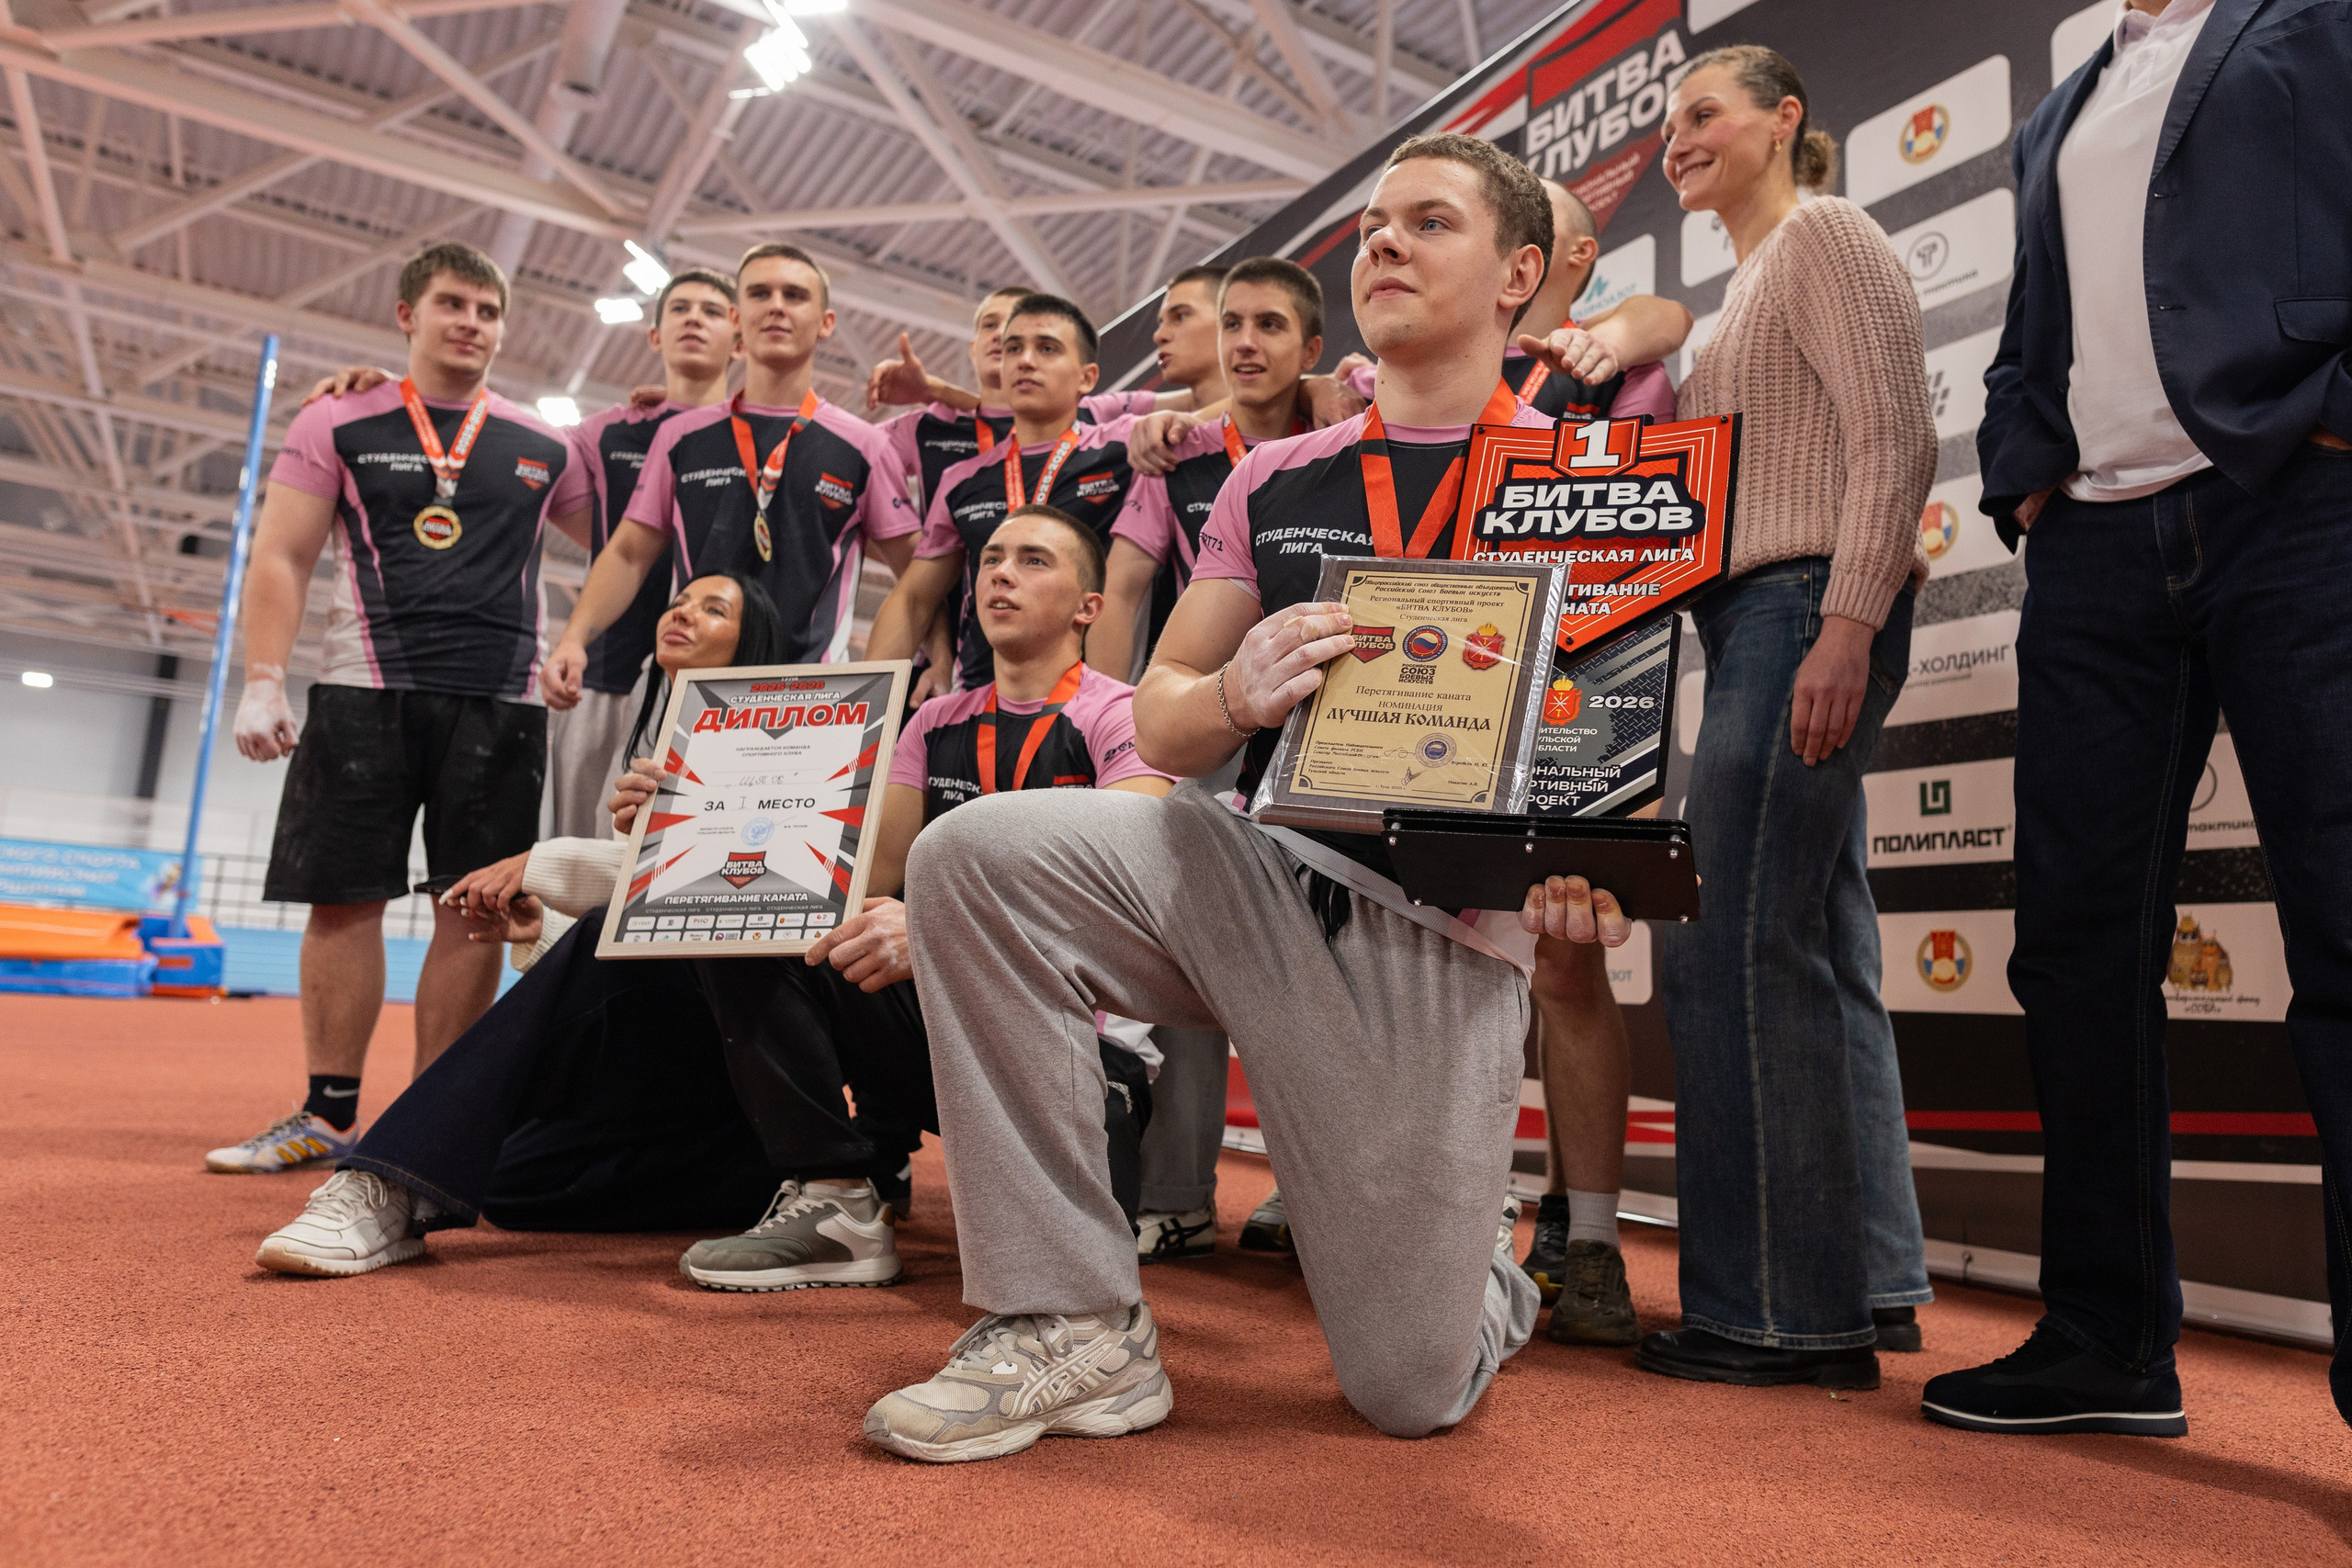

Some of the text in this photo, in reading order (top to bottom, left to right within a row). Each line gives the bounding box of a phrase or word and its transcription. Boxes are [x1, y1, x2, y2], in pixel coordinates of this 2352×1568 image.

[1525, 28, 1687, 156] БИТВА
[1527, 61, 1687, 178] ЛУБО
[1569, 420, 1620, 469] 1
[356, 453, 430, 465] СТУДЕНЧЕС
[1501, 479, 1680, 511] БИТВА
[1482, 505, 1694, 536] КЛУБОВ
[1255, 527, 1374, 547] СТУДЕНЧЕСКАЯ
[1280, 542, 1323, 555] ЛИГА
[1472, 547, 1696, 564] СТУДЕНЧЕСКАЯ ЛИГА
[1374, 585, 1416, 593] Российский
[1567, 582, 1661, 596] ГИВАНИЕ
[1370, 594, 1425, 604] Региональный
[1427, 598, 1475, 606] спортивный
[1396, 604, 1474, 614] «БИТВА КЛУБОВ»
[1564, 602, 1611, 615] НАТА
[1399, 613, 1468, 624] Студенческая лига
[1352, 634, 1391, 643] БИТВА
[1354, 641, 1394, 649] ЛУБОВ
[1909, 643, 2011, 677] -ХОЛДИНГ
[1400, 667, 1436, 676] СОЮЗ
[750, 681, 826, 693] 2025-2026
[1355, 685, 1472, 701] Перетягивание каната
[729, 692, 841, 705] СТУДЕНЧЕСКАЯ ЛИГА
[1588, 694, 1655, 710] 2026
[1377, 700, 1443, 712] НОМИНАЦИЯ
[693, 702, 869, 734] ДИПЛОМ
[1326, 707, 1491, 731] ЛУЧШАЯ КОМАНДА
[1540, 728, 1598, 736] ИТЕЛЬСТВО
[1530, 780, 1609, 793] РТИВНЫЙ
[704, 801, 725, 811] ЗА
[758, 797, 816, 810] МЕСТО
[1527, 795, 1580, 807] РОЕКТ
[1872, 828, 2006, 855] ПОЛИПЛАСТ
[721, 866, 765, 876] КЛУБОВ
[726, 861, 763, 869] БИТВА
[664, 893, 809, 906] ПЕРЕТЯГИВАНИЕ КАНАТА
